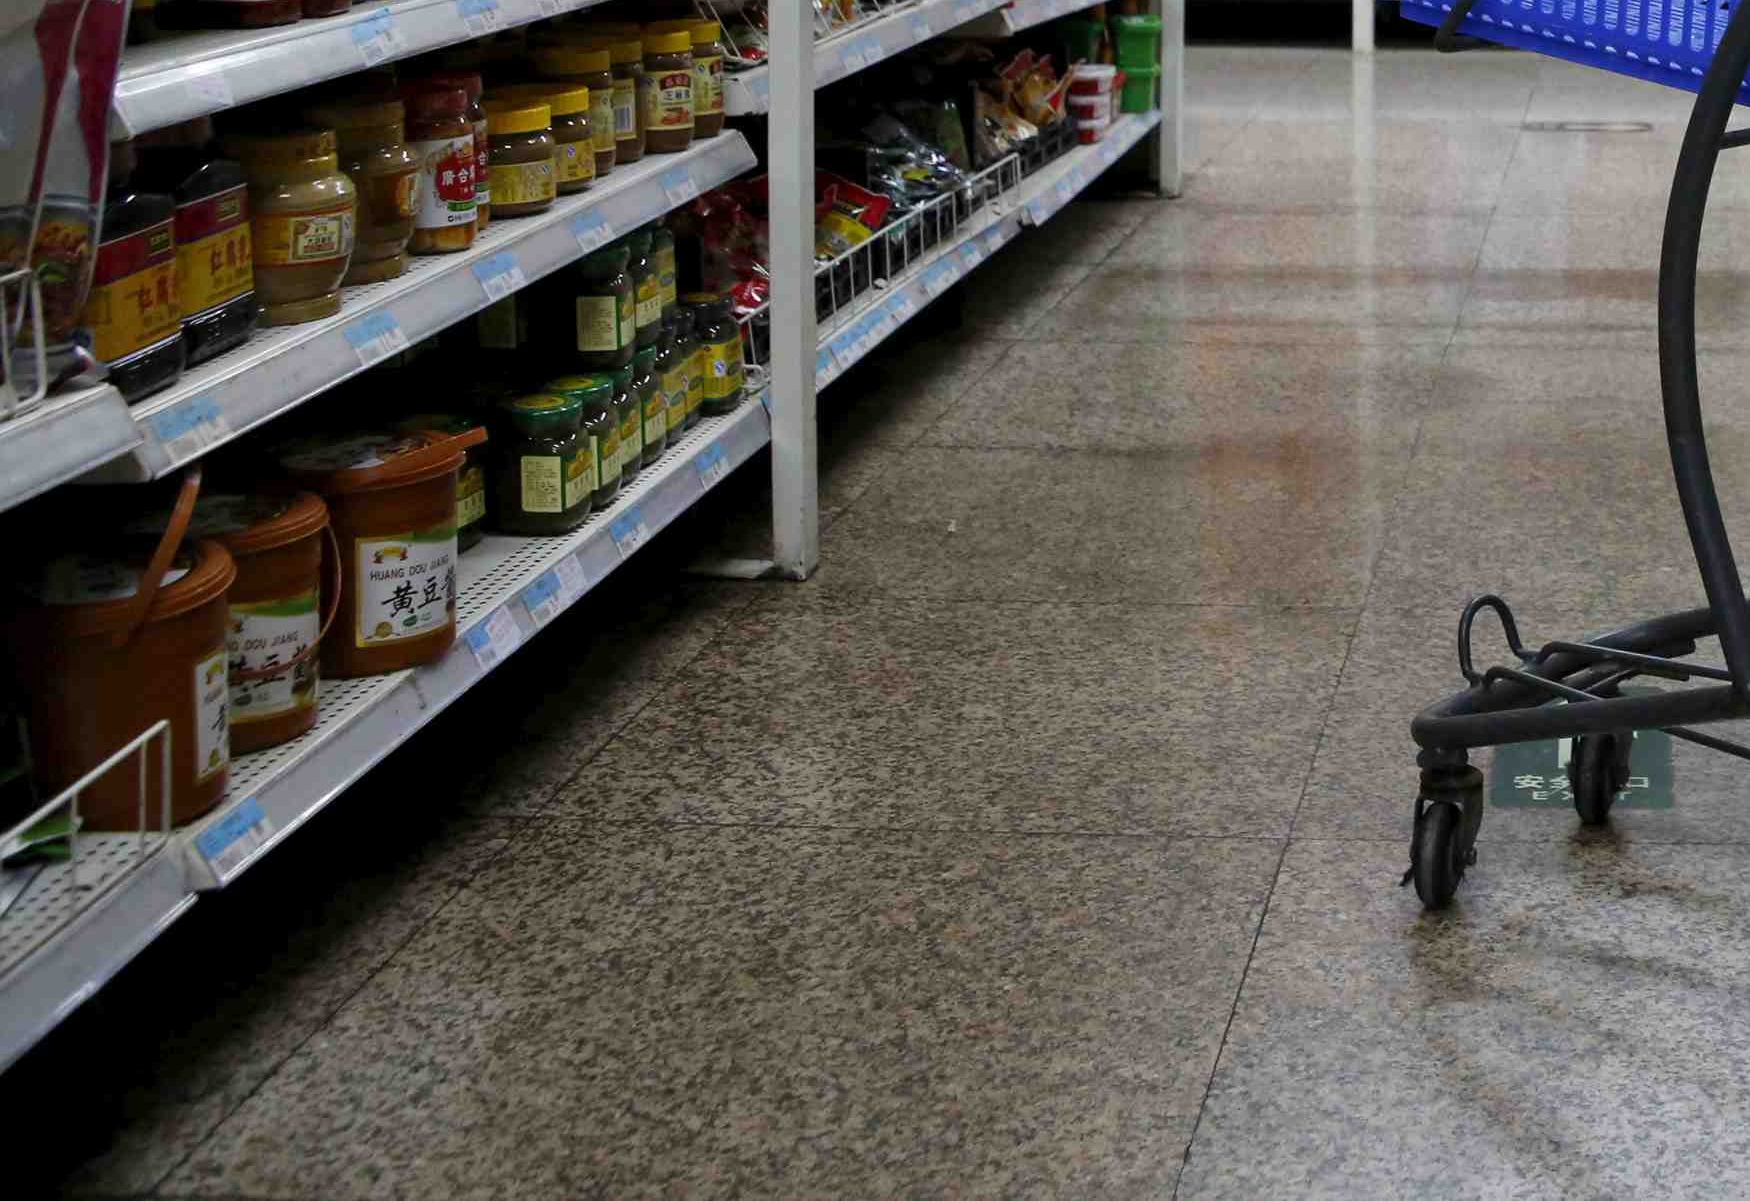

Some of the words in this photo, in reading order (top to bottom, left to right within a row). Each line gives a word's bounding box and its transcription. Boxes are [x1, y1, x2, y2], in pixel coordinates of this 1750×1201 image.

[369, 568, 405, 582] HUANG
[1513, 774, 1649, 789] 安全口
